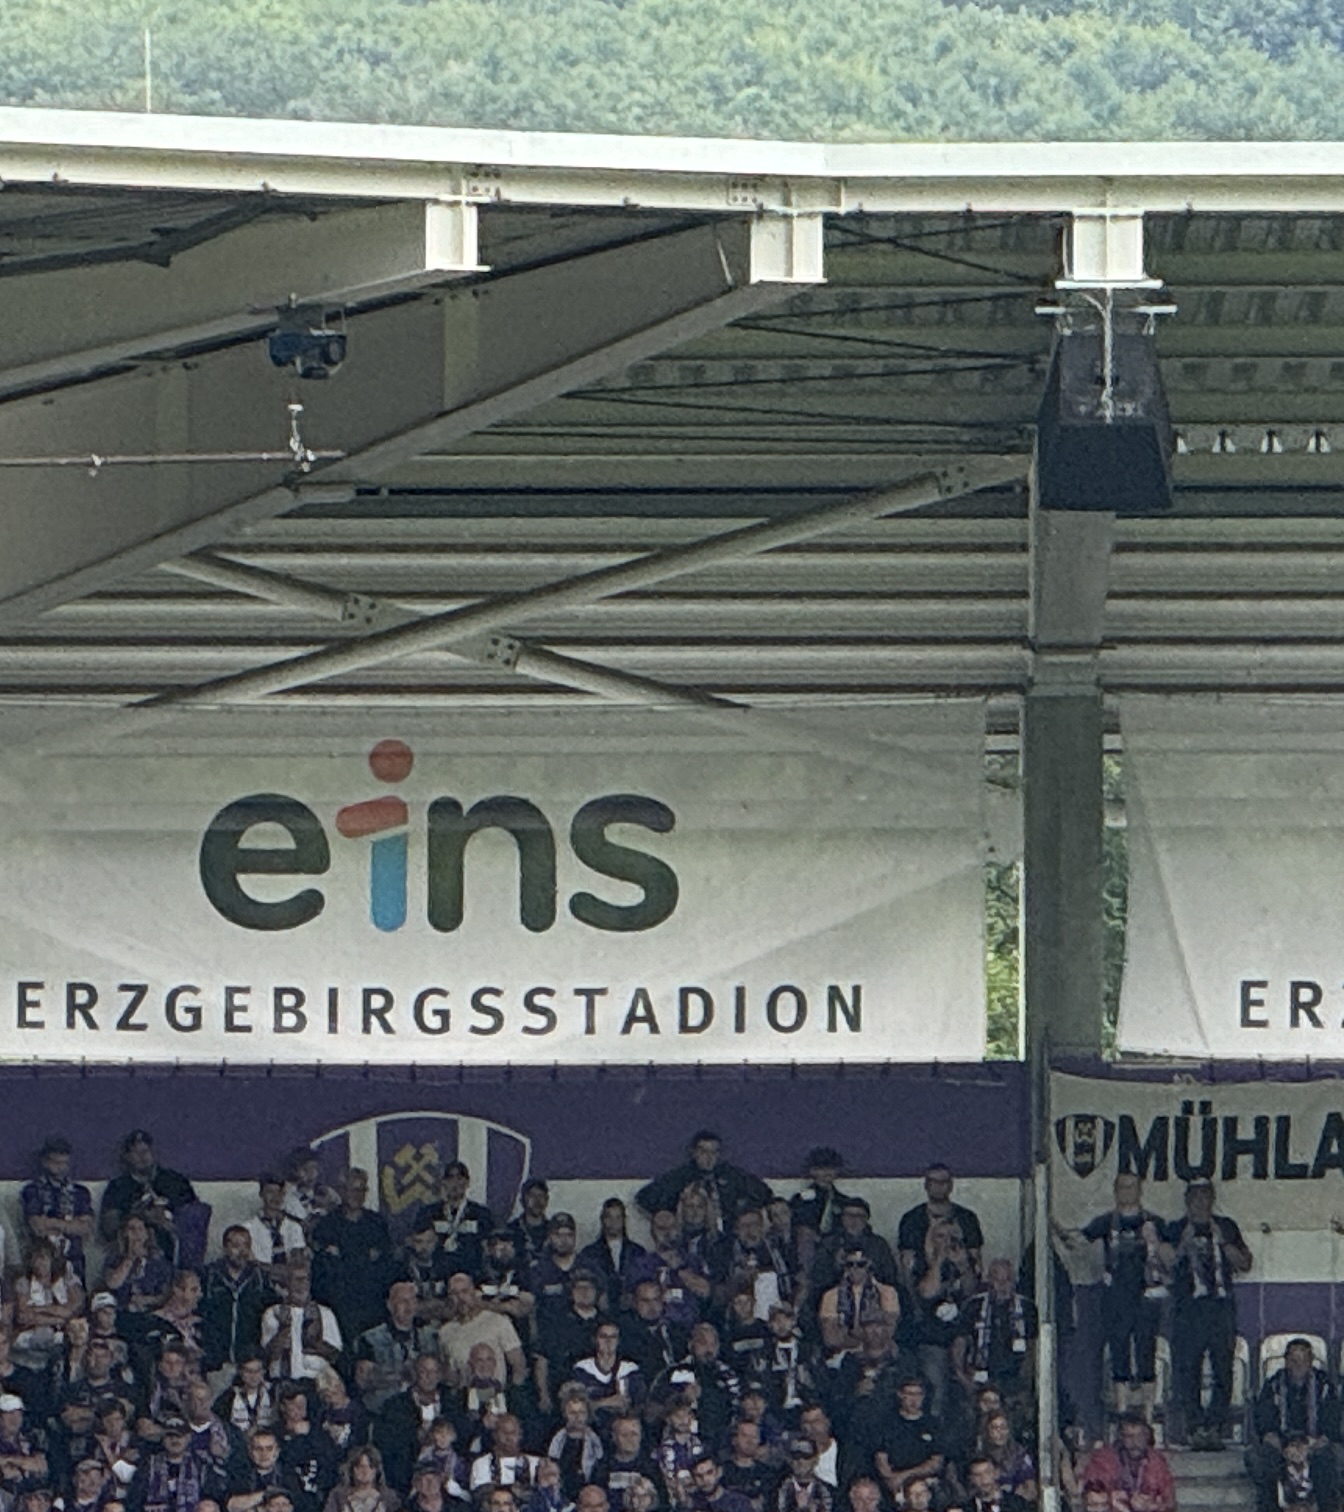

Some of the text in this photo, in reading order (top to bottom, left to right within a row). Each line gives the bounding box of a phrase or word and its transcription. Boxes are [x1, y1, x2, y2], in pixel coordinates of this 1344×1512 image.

[199, 738, 680, 933] eins
[15, 980, 866, 1036] ERZGEBIRGSSTADION
[1239, 980, 1344, 1029] ER
